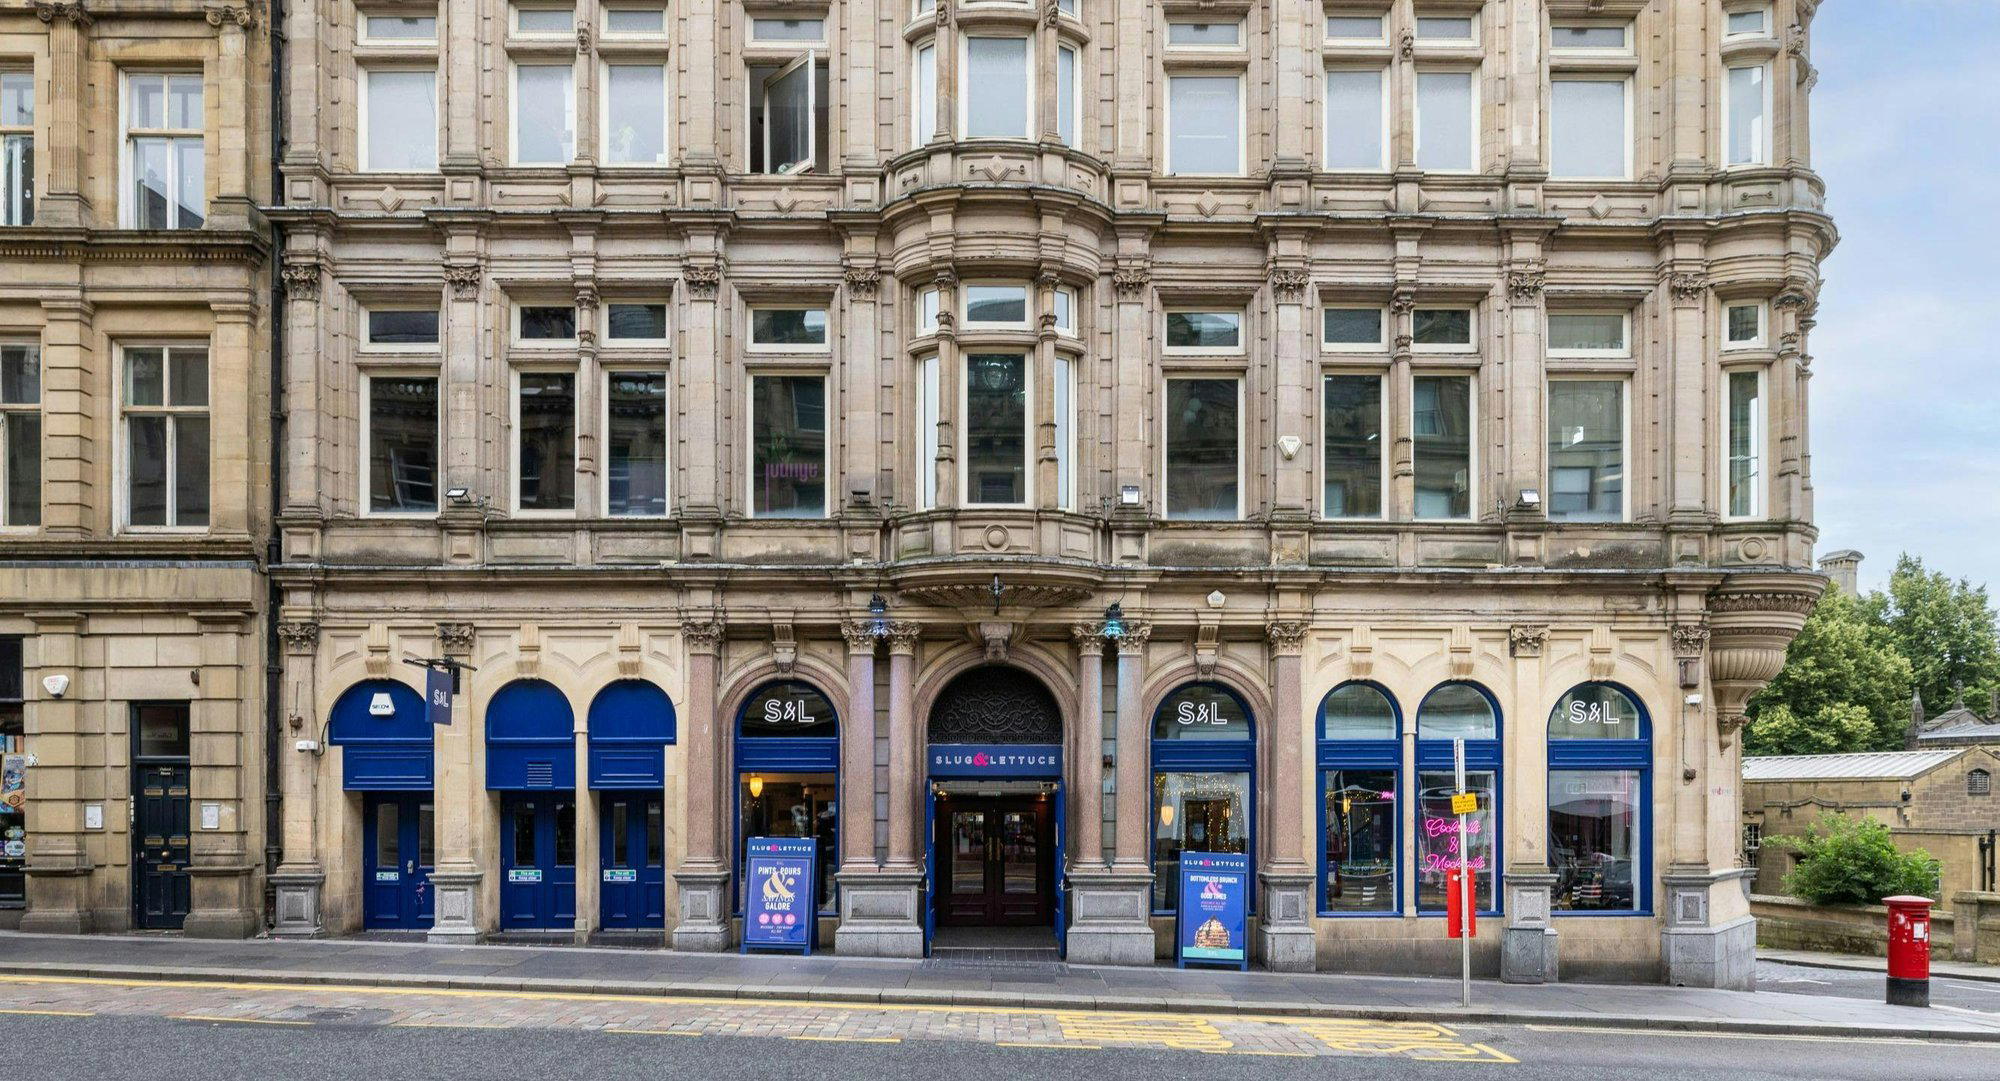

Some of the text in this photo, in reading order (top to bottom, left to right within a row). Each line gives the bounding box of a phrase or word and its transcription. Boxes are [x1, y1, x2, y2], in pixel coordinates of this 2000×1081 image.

[433, 689, 449, 708] S&L
[764, 699, 815, 723] S&L
[1177, 701, 1228, 725] S&L
[1569, 700, 1620, 724] S&L
[1426, 818, 1482, 837] Cockils
[1448, 836, 1459, 854] &
[1421, 853, 1486, 873] Mockails
[764, 902, 791, 911] GALORE
